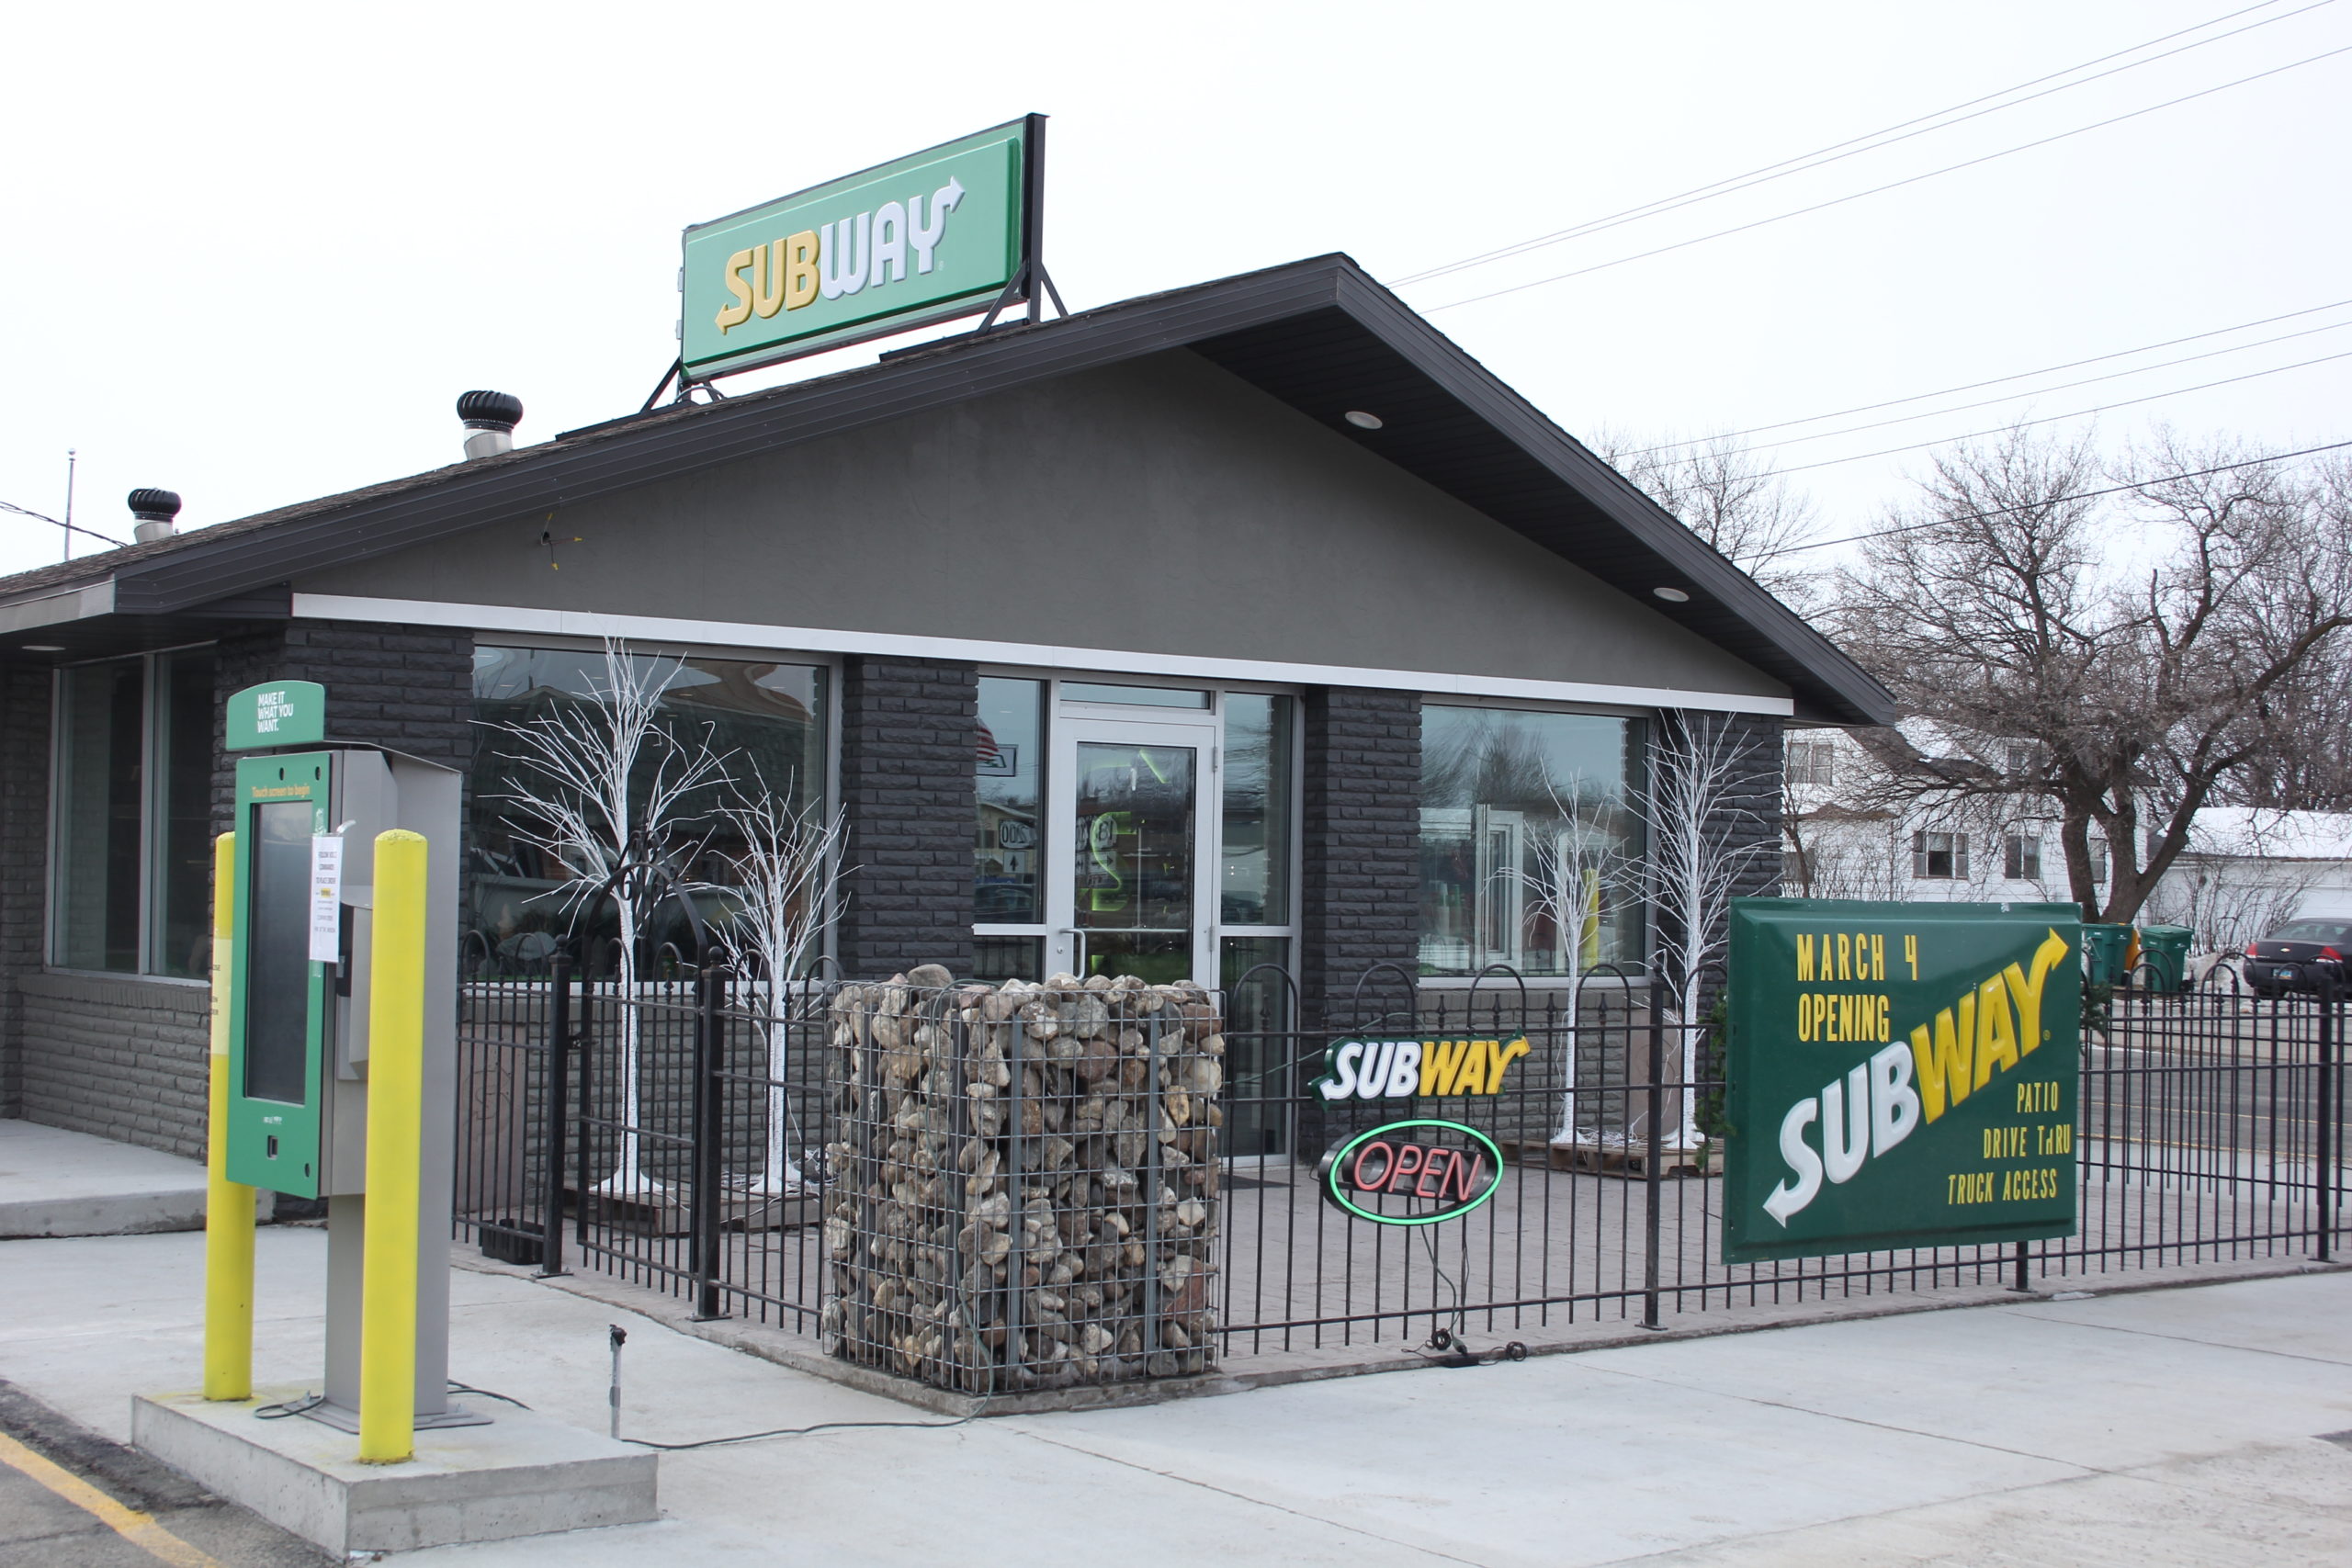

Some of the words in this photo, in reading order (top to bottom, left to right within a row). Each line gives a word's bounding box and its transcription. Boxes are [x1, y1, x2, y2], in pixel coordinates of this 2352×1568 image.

[714, 175, 966, 336] SUBWAY
[257, 692, 277, 706] MAKE
[277, 691, 286, 705] IT
[257, 705, 277, 719] WHAT
[278, 703, 294, 717] YOU
[251, 785, 267, 797] Touch
[267, 787, 287, 796] screen
[294, 783, 310, 797] begin
[1796, 932, 1884, 982] MARCH
[1904, 934, 1918, 981] 4
[1798, 993, 1890, 1043] OPENING
[1319, 1035, 1532, 1101] SUBWAY
[1762, 927, 2069, 1229] SUBWAY
[2017, 1081, 2059, 1113] PATIO
[1983, 1126, 2027, 1159] DRIVE
[1354, 1141, 1482, 1202] OPEN
[1948, 1174, 1994, 1205] TRUCK
[2002, 1168, 2058, 1201] ACCESS
